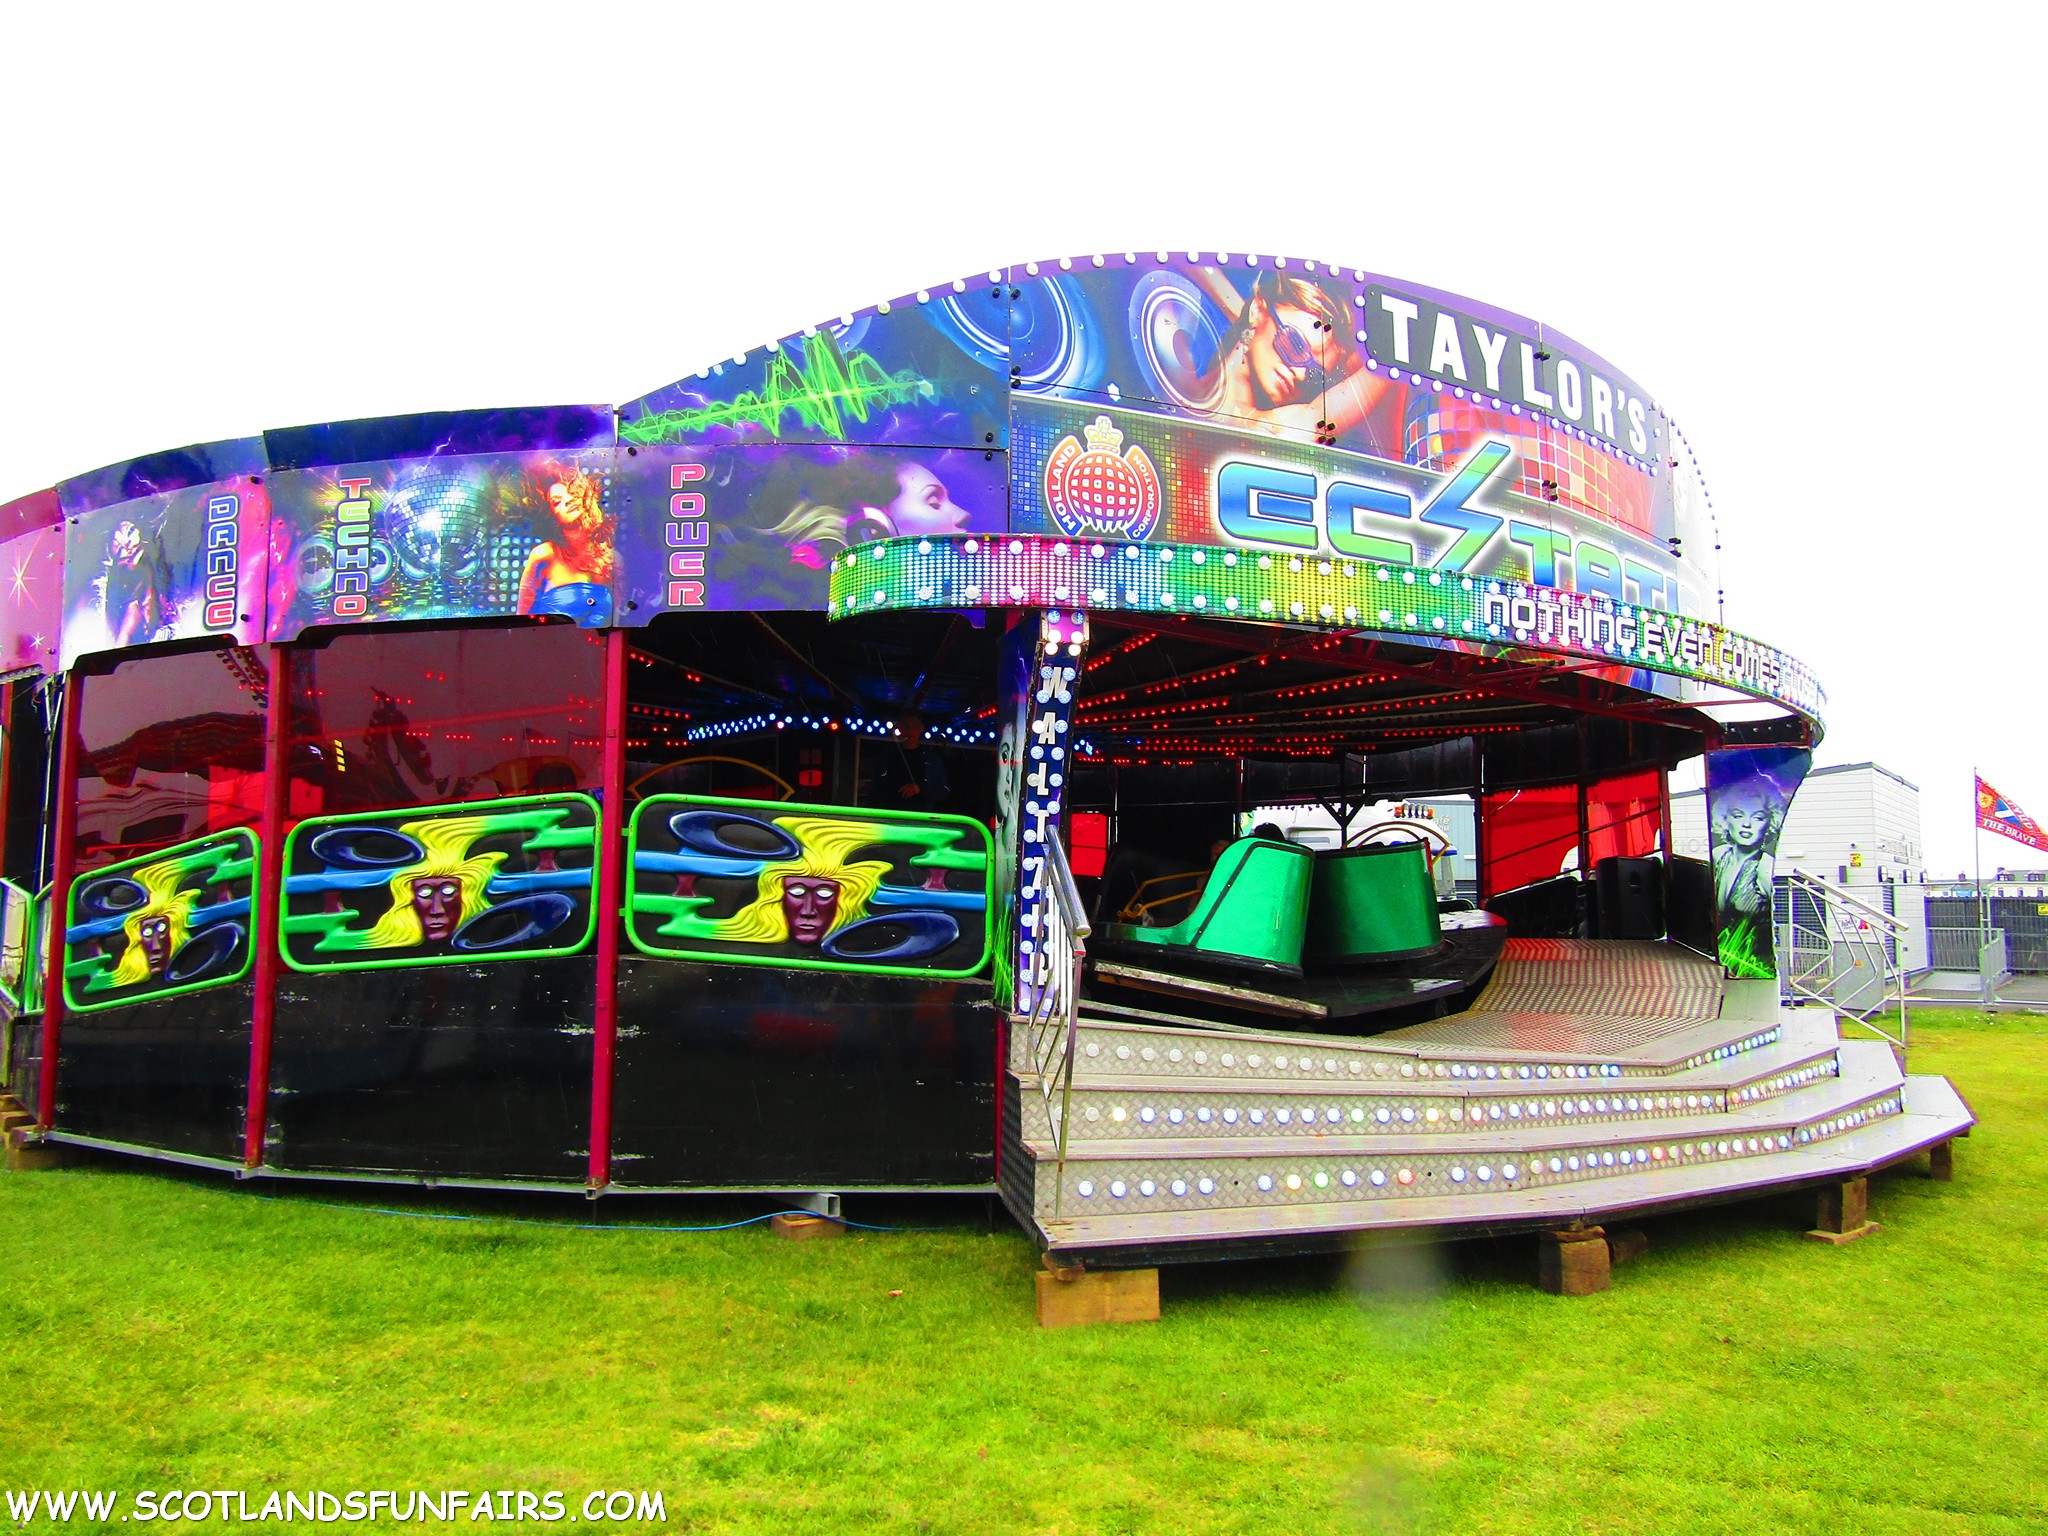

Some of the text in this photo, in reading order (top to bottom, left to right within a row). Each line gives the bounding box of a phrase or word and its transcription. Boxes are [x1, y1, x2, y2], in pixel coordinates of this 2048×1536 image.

[1380, 293, 1648, 456] TAYLOR'S
[665, 463, 710, 606] POWER
[1051, 444, 1077, 531] HOLLAND
[1131, 454, 1155, 538] CORPORATION
[205, 495, 239, 627] DANCE
[334, 477, 372, 617] TECHNO
[1483, 592, 1637, 649] NOTHING
[1643, 621, 1713, 666] EVEN
[1720, 640, 1780, 688] COMES
[1982, 818, 2038, 845] THE BRAVE
